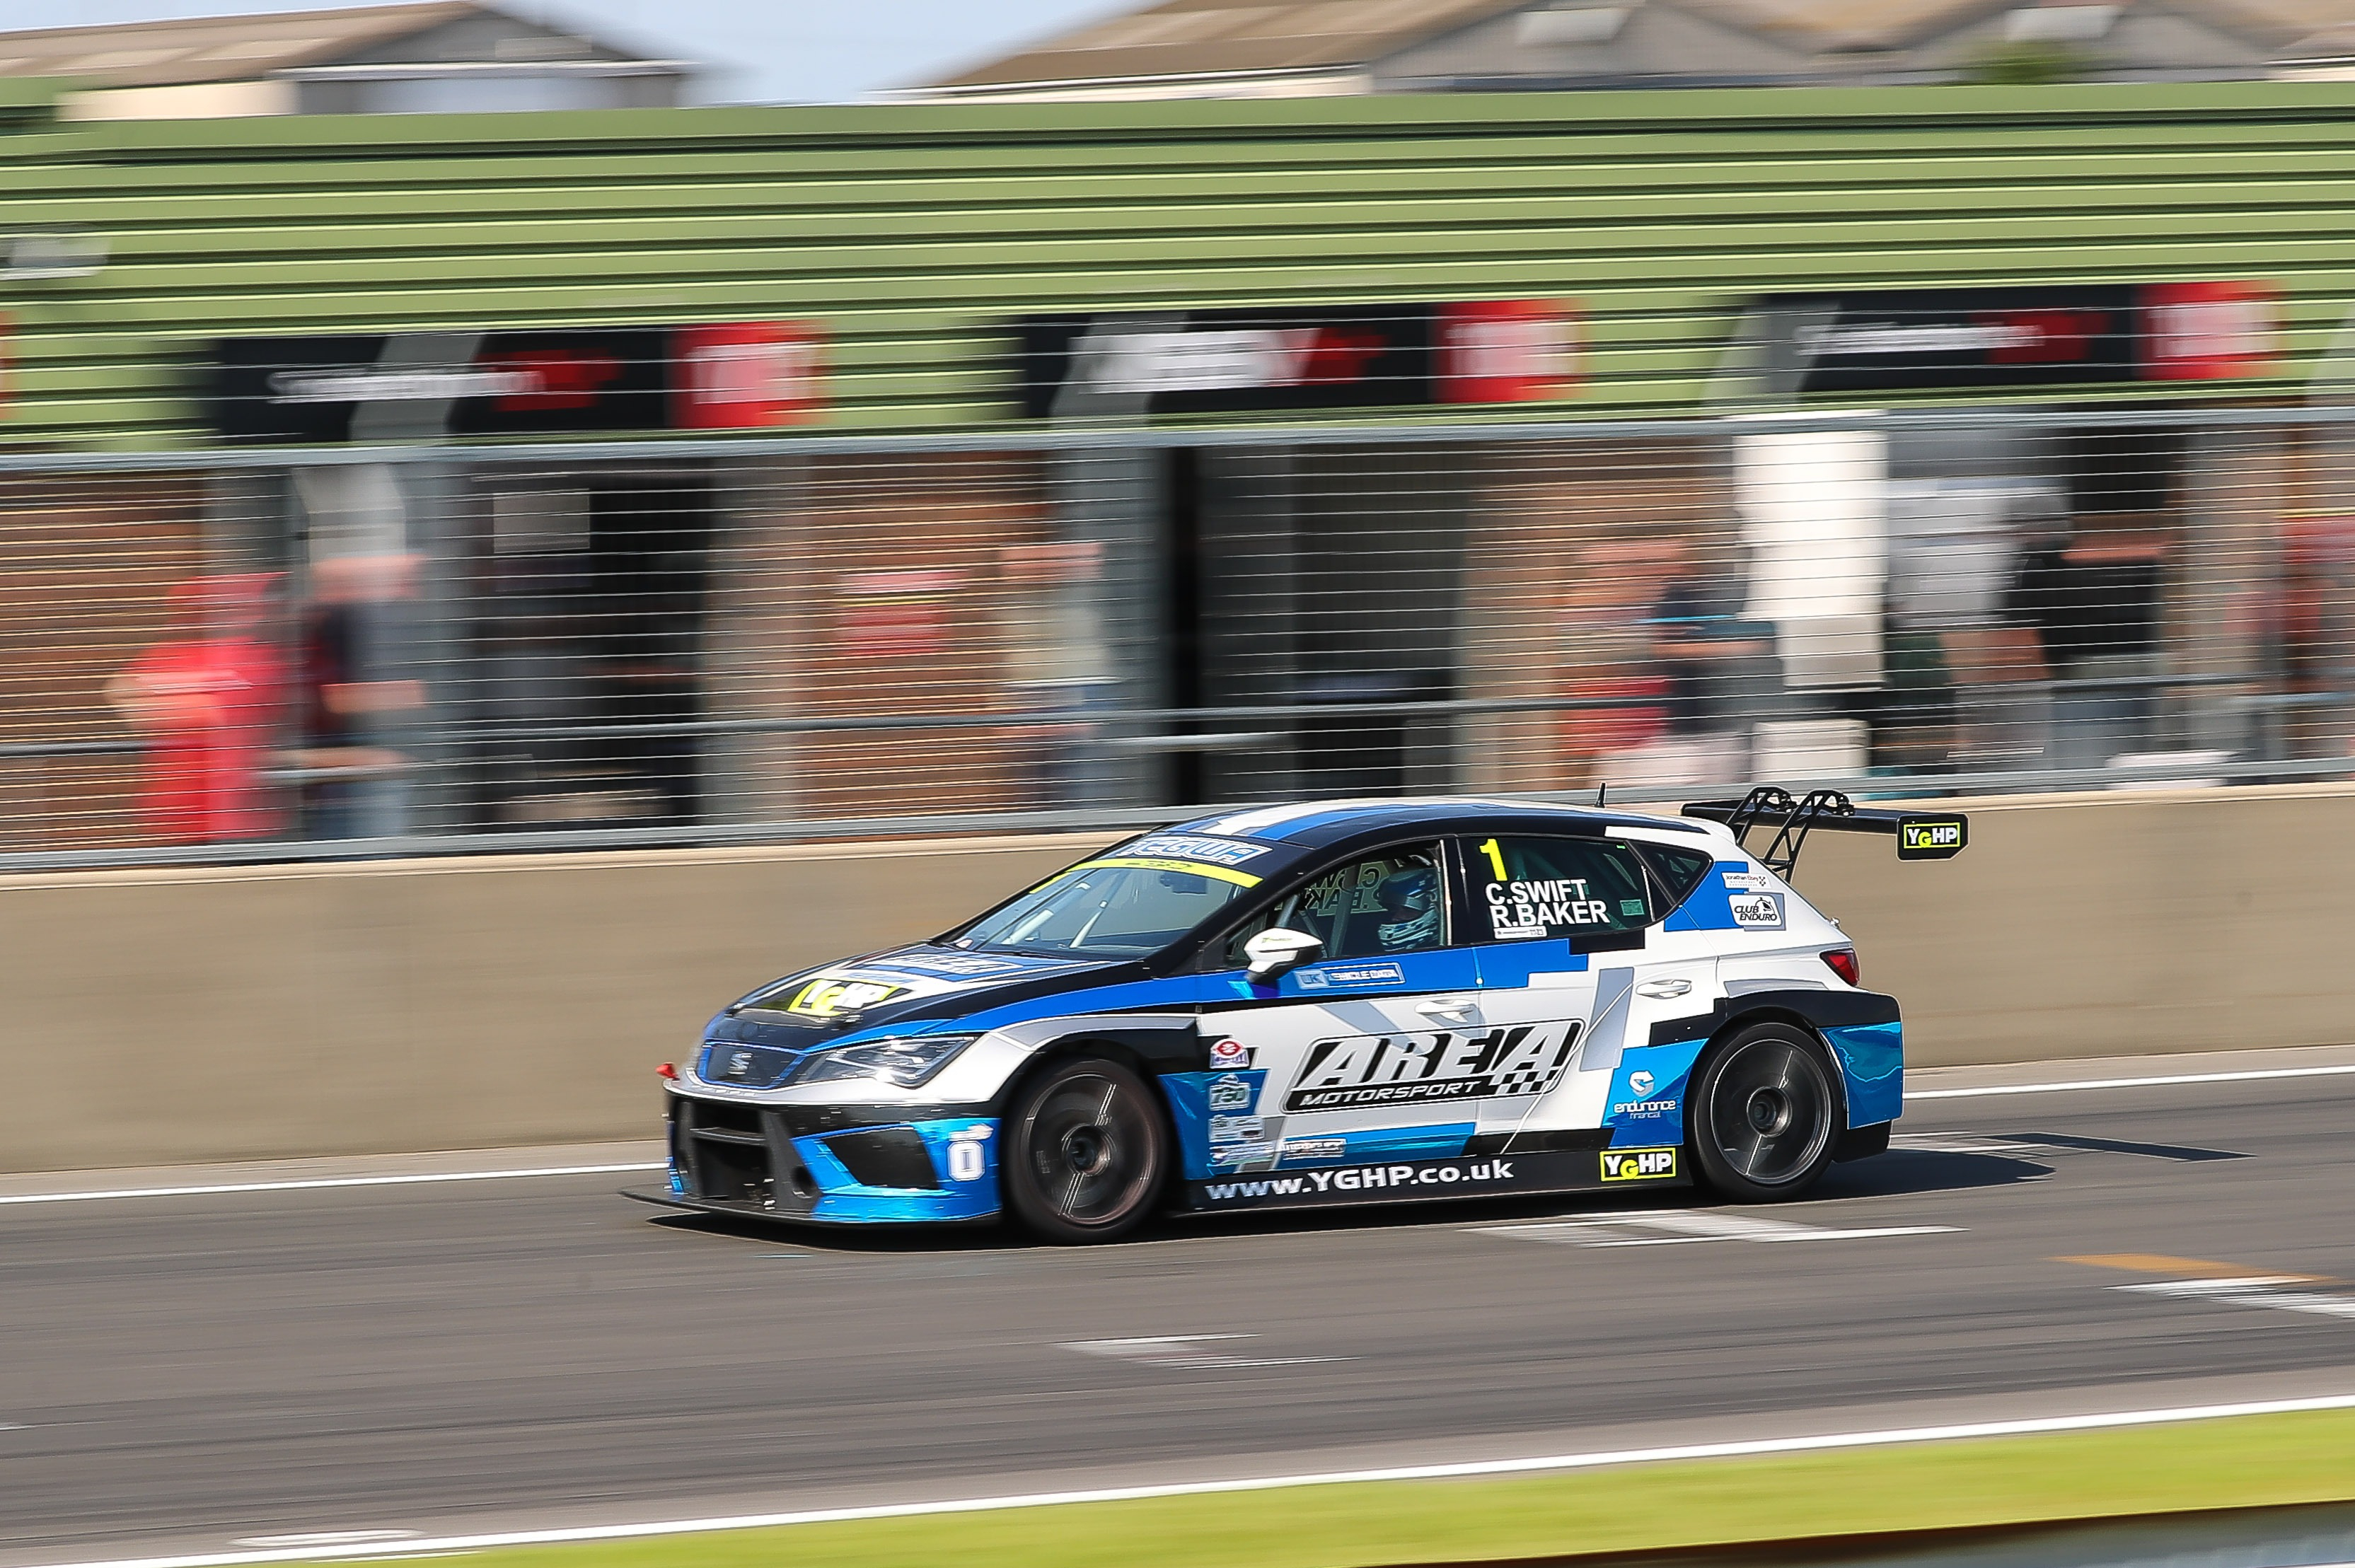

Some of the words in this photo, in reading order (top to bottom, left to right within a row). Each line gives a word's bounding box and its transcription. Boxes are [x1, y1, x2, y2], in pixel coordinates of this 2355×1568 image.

[1907, 827, 1957, 847] YGHP
[1479, 839, 1508, 881] 1
[1486, 878, 1587, 905] C.SWIFT
[1489, 900, 1611, 928] R.BAKER
[1734, 905, 1759, 914] CLUB
[1740, 913, 1777, 922] ENDURO
[803, 980, 890, 1012] YGHP
[1295, 1023, 1576, 1088] AREA
[1299, 1080, 1481, 1106] MOTORSPORT
[1205, 1160, 1514, 1200] www.YGHP.co.uk
[1604, 1153, 1672, 1180] YGHP
